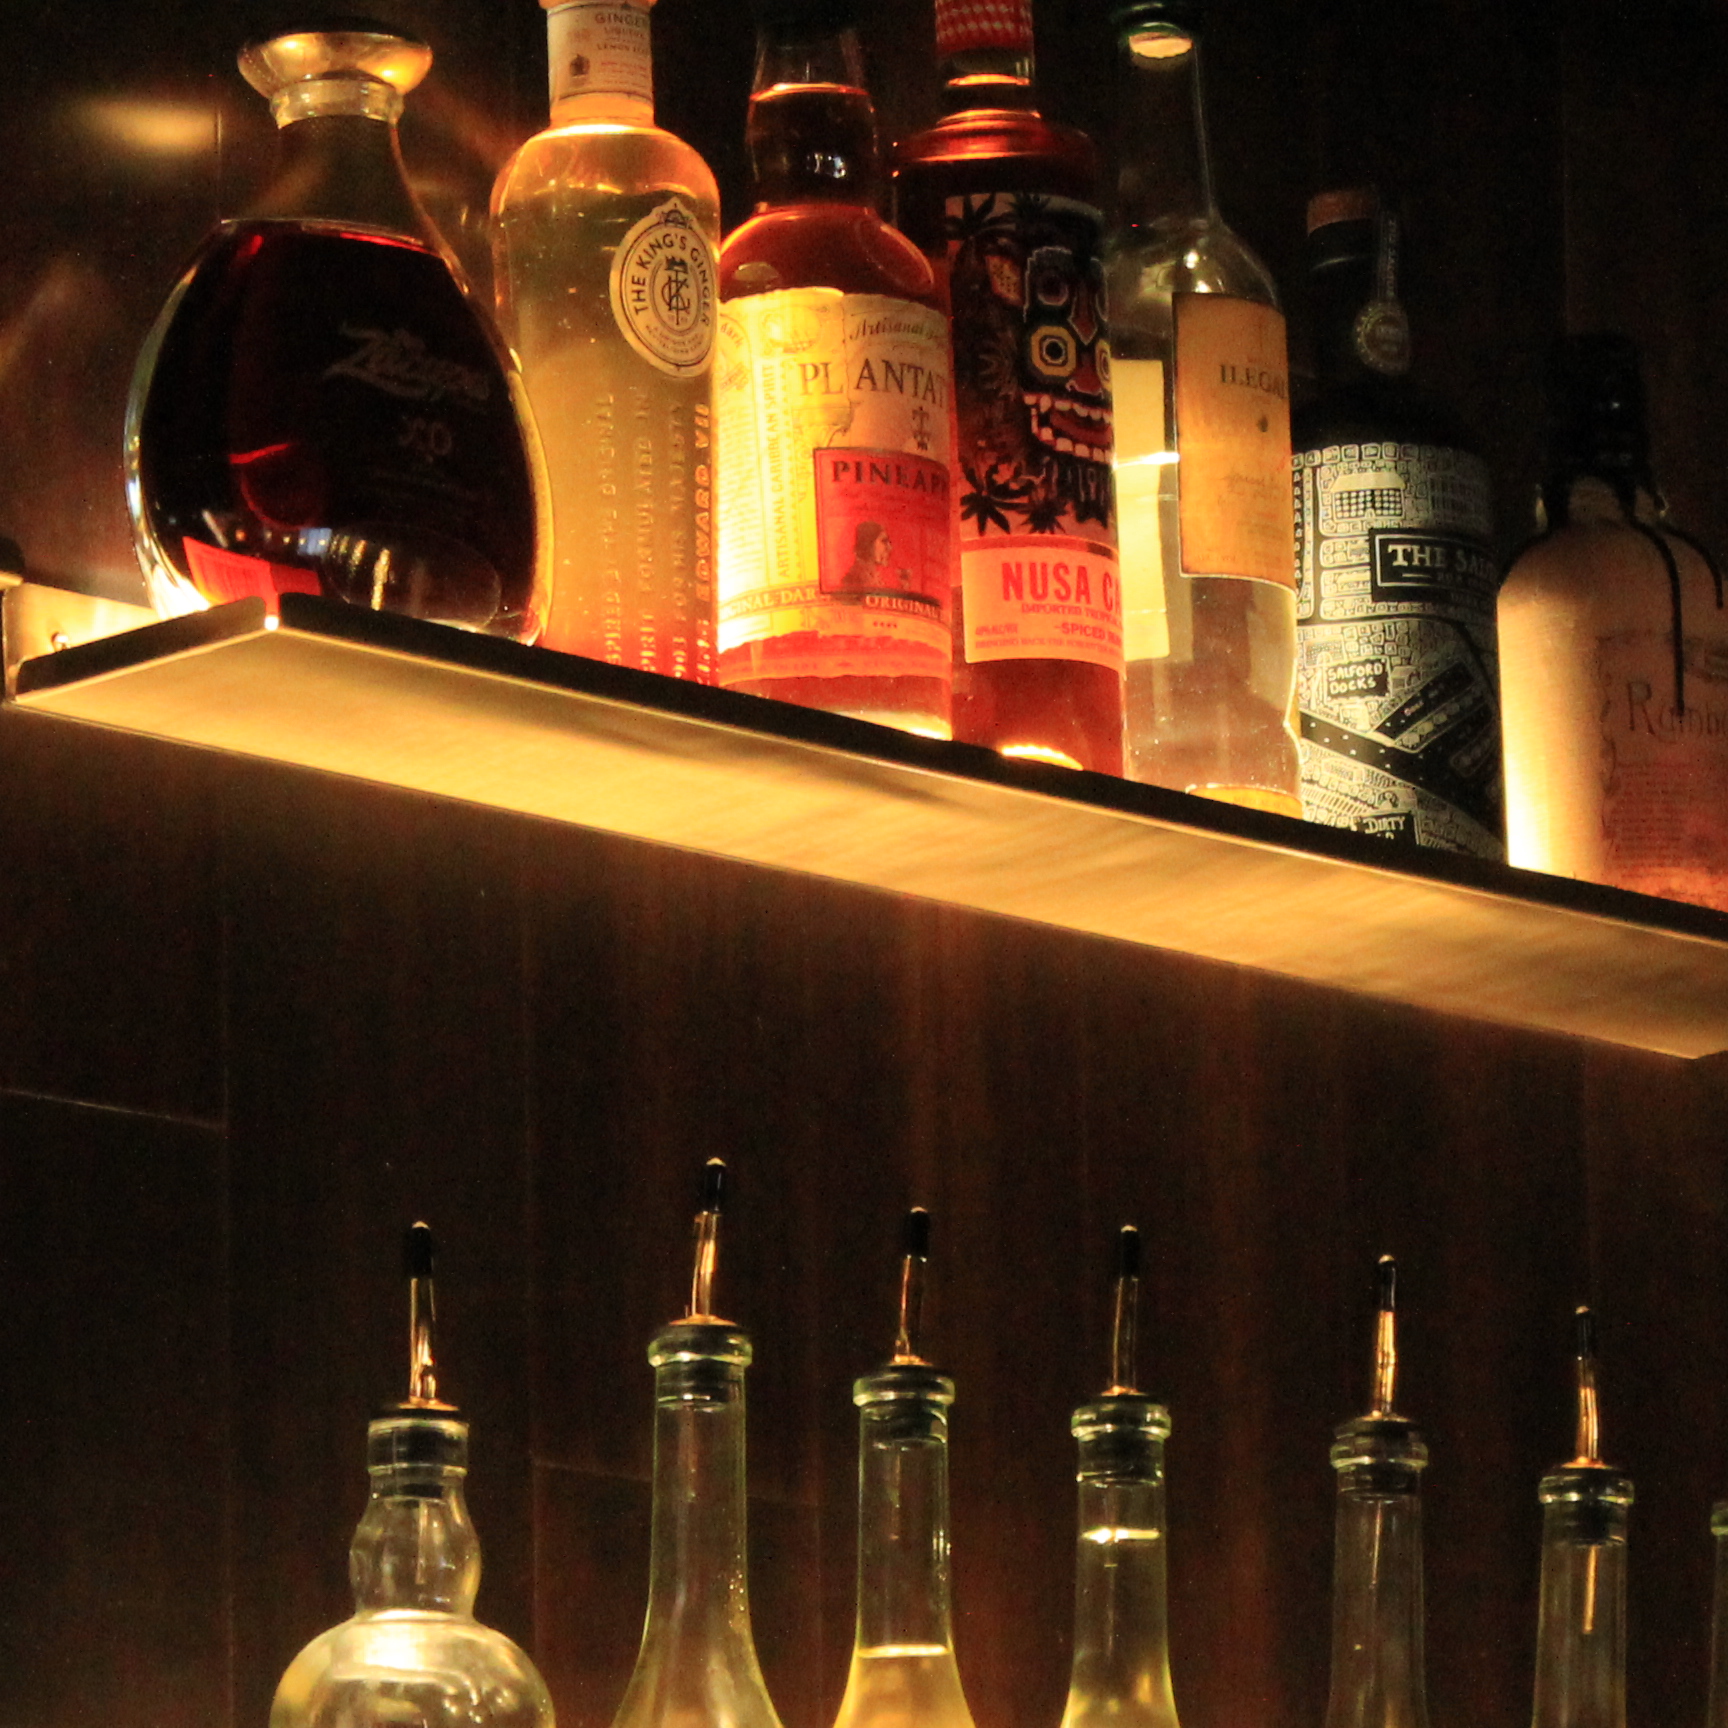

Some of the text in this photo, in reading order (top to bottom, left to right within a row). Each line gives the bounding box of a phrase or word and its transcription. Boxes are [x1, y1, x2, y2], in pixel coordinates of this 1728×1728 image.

[632, 233, 710, 328] THE KING'S GINGER
[1387, 543, 1449, 570] THE
[1001, 561, 1092, 605] NUSA
[865, 595, 940, 620] ORIGINAL
[1327, 662, 1384, 683] SALFORD
[1330, 678, 1377, 697] DOCKS
[1363, 814, 1407, 835] DIRTY
